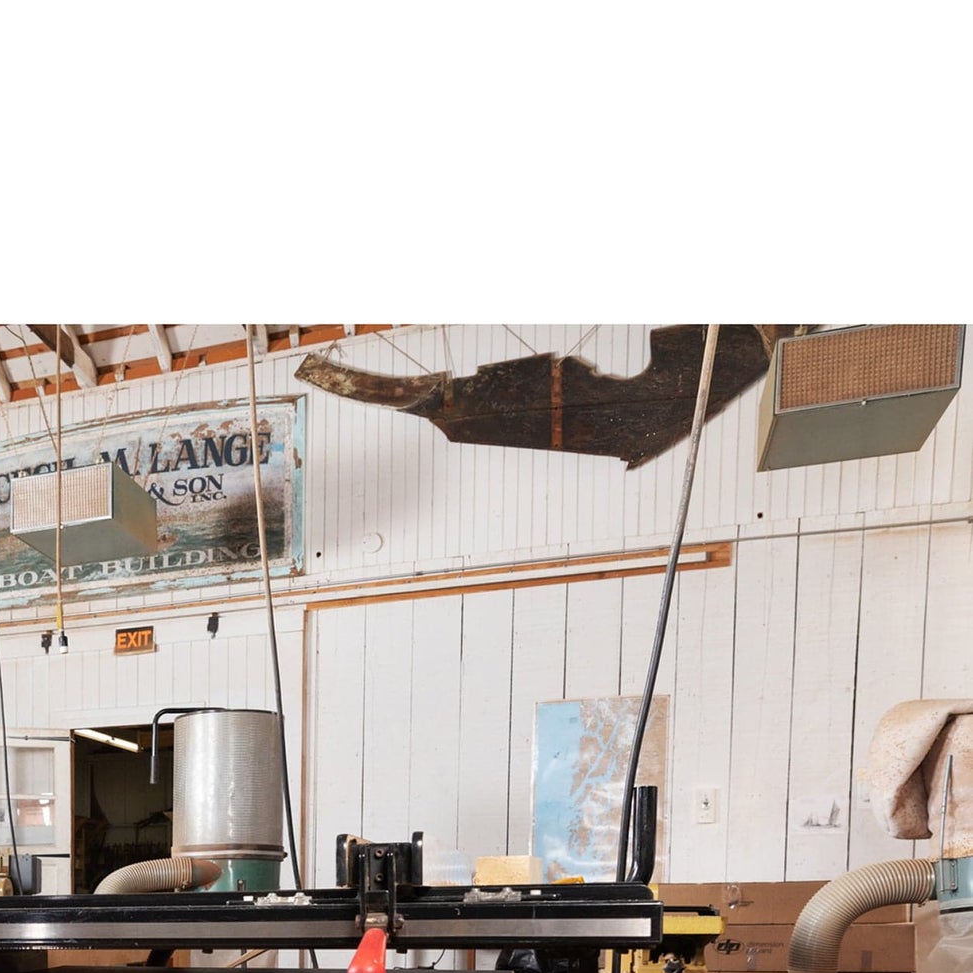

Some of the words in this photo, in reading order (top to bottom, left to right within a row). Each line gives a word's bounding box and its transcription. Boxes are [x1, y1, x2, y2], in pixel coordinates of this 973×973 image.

[149, 432, 271, 475] LANGE
[148, 481, 185, 506] &
[173, 473, 224, 497] SON
[191, 492, 227, 503] INC.
[100, 543, 261, 576] BUILDING
[117, 631, 152, 649] EXIT
